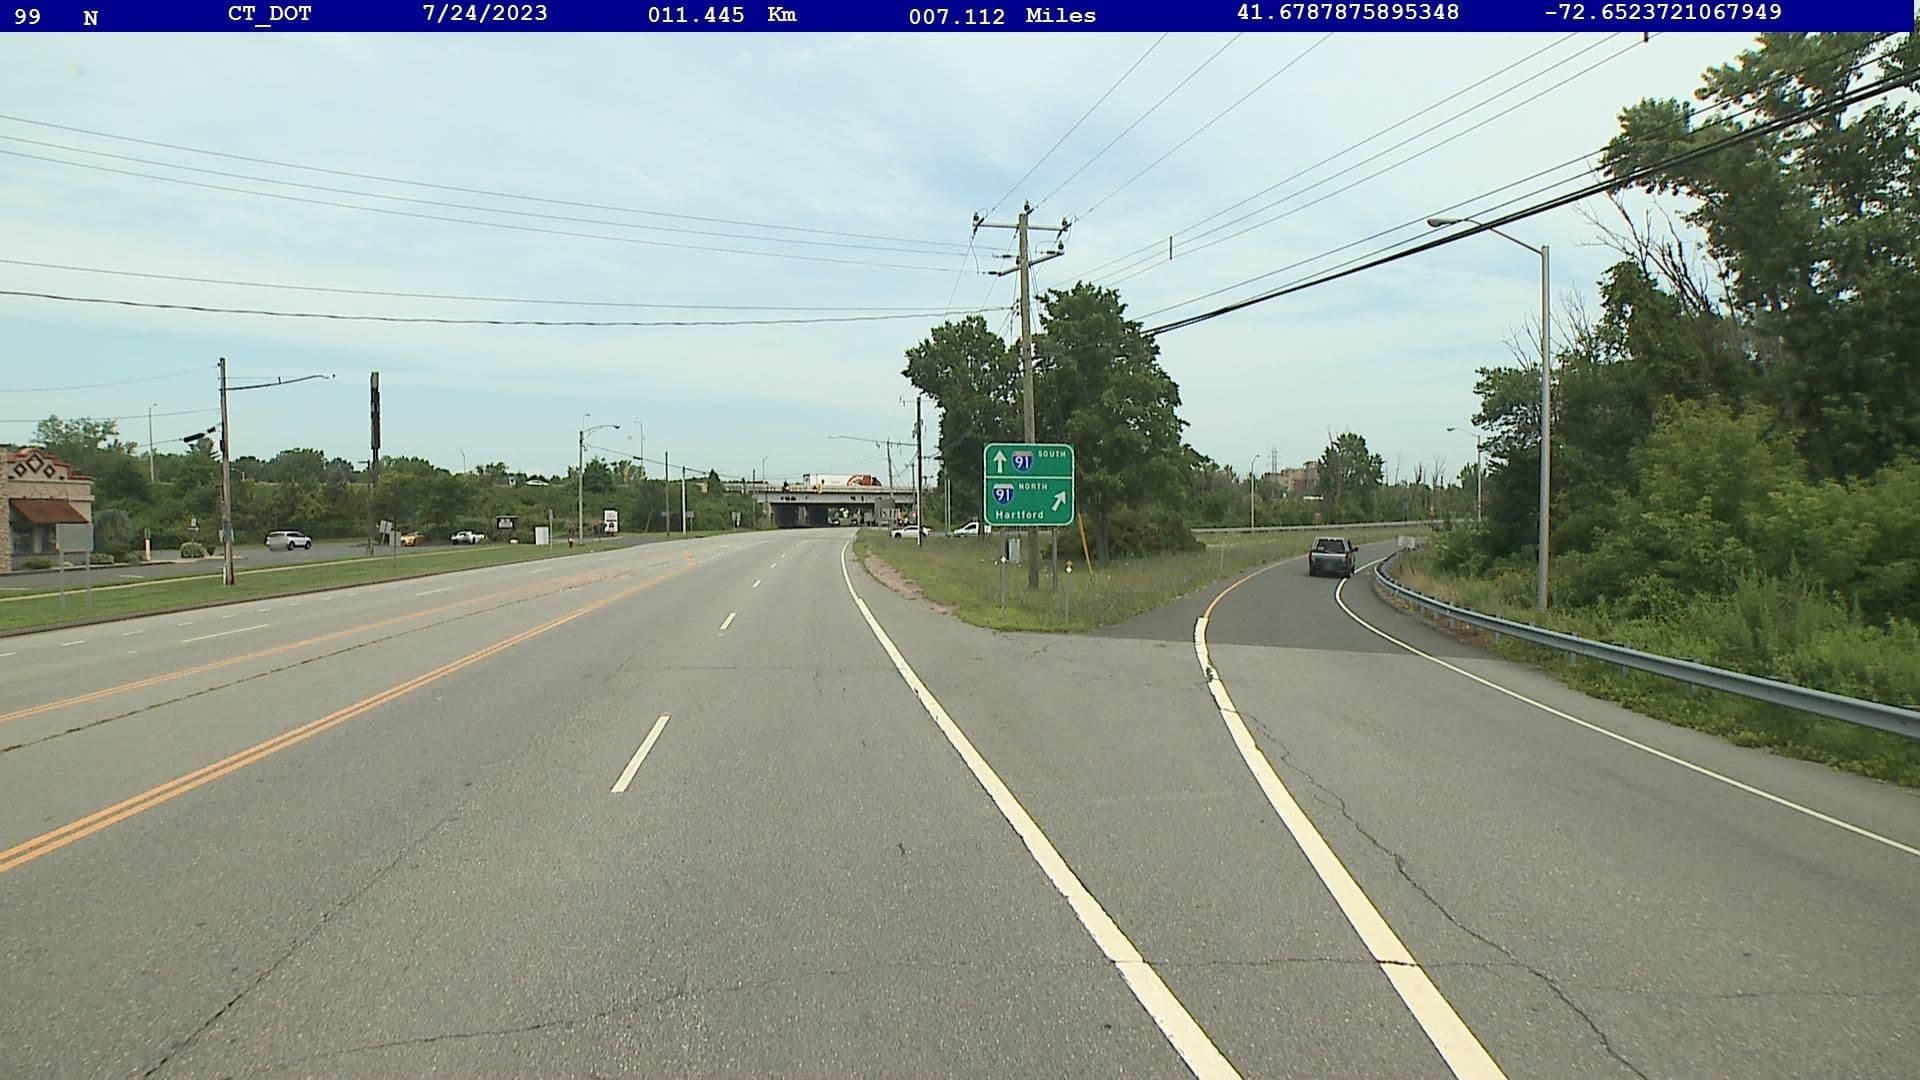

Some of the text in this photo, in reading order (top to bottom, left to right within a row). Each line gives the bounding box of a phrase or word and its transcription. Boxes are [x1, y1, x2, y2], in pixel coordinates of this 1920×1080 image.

[1038, 450, 1066, 458] SOUTH
[1014, 456, 1029, 469] 91
[995, 489, 1010, 501] 91
[995, 510, 1044, 519] Hartford
